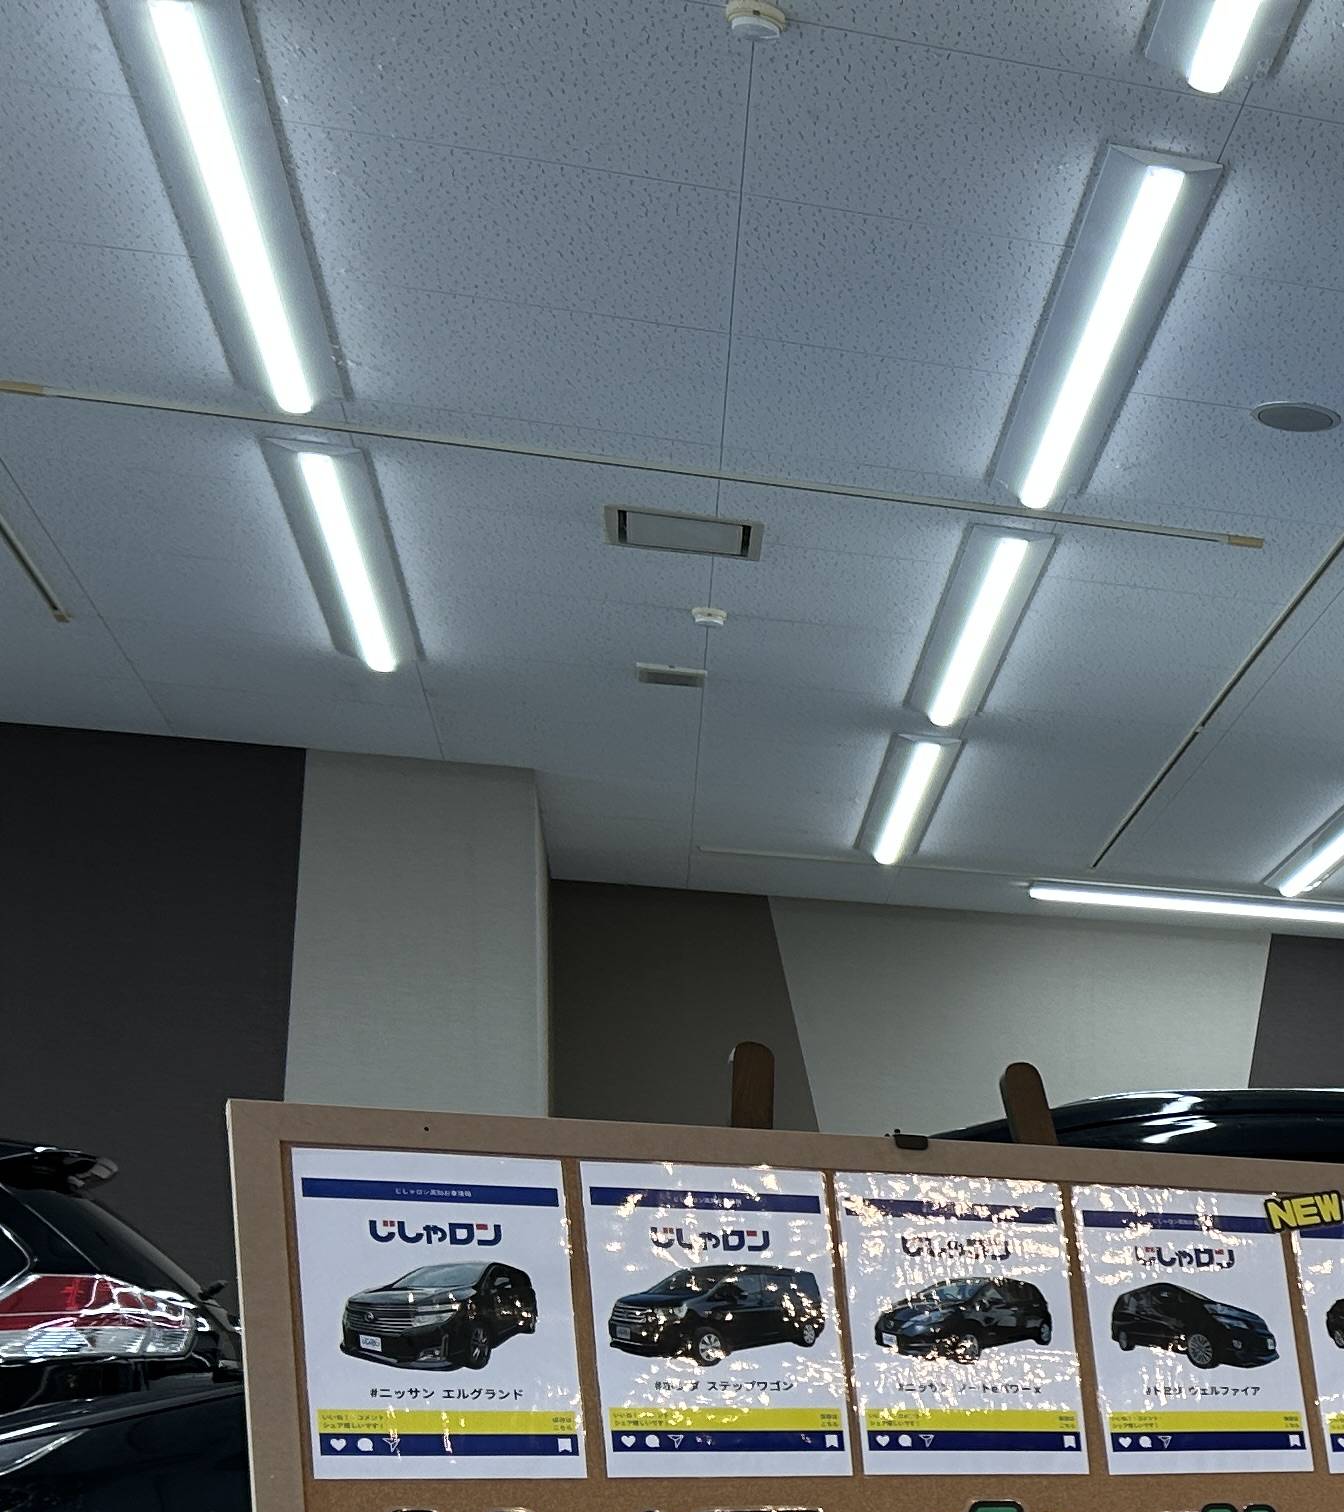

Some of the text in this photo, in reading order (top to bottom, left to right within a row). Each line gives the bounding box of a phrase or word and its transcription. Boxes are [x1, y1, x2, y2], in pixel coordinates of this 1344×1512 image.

[1266, 1191, 1344, 1231] NEW
[369, 1220, 502, 1246] じしゃロン
[370, 1388, 524, 1400] #ニッサン エルグランド
